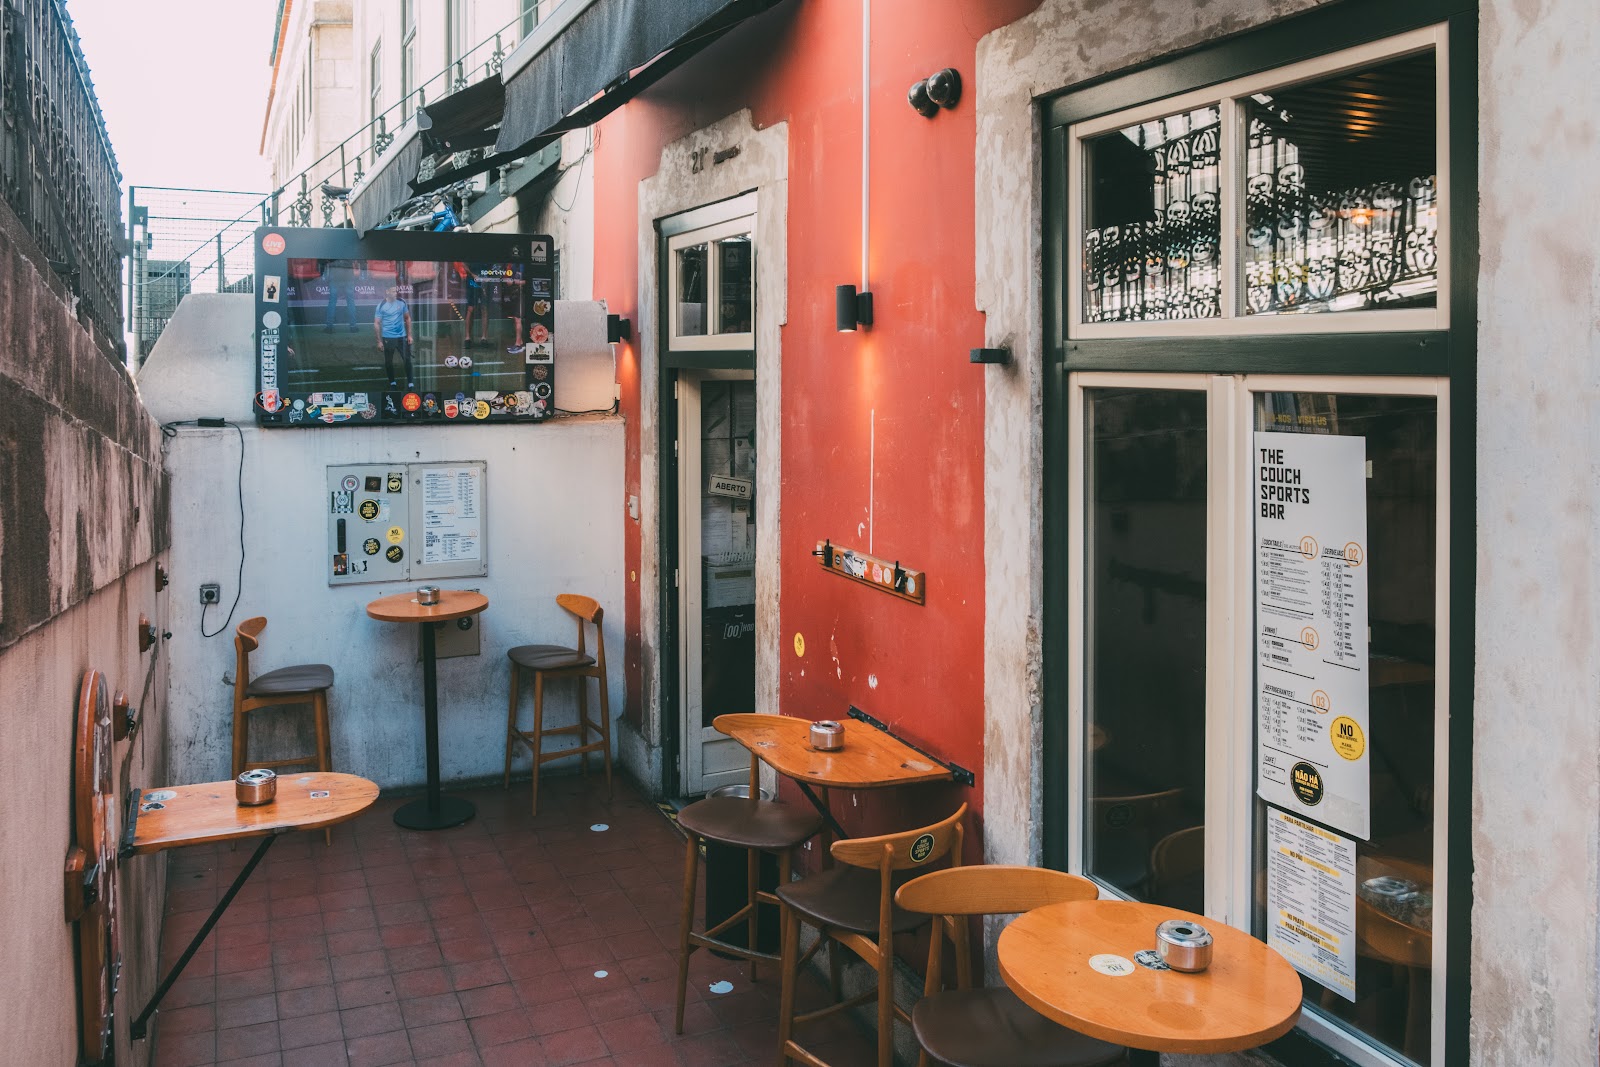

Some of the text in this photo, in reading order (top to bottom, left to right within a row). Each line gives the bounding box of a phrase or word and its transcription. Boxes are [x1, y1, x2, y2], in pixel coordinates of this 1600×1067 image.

[1261, 448, 1284, 464] THE
[1261, 466, 1300, 484] COUCH
[716, 482, 746, 492] ABERTO
[1261, 485, 1310, 504] SPORTS
[1261, 502, 1285, 520] BAR
[1304, 542, 1312, 553] 01
[1349, 548, 1358, 560] 02
[1306, 632, 1314, 644] 03
[1316, 696, 1325, 707] 03
[1340, 723, 1353, 736] NO
[1295, 769, 1318, 786] NÃO HÁ
[1284, 815, 1293, 824] PARA
[1293, 915, 1304, 926] PRATO
[1285, 922, 1294, 930] PARA
[1295, 926, 1320, 944] ACOMPANHAR
